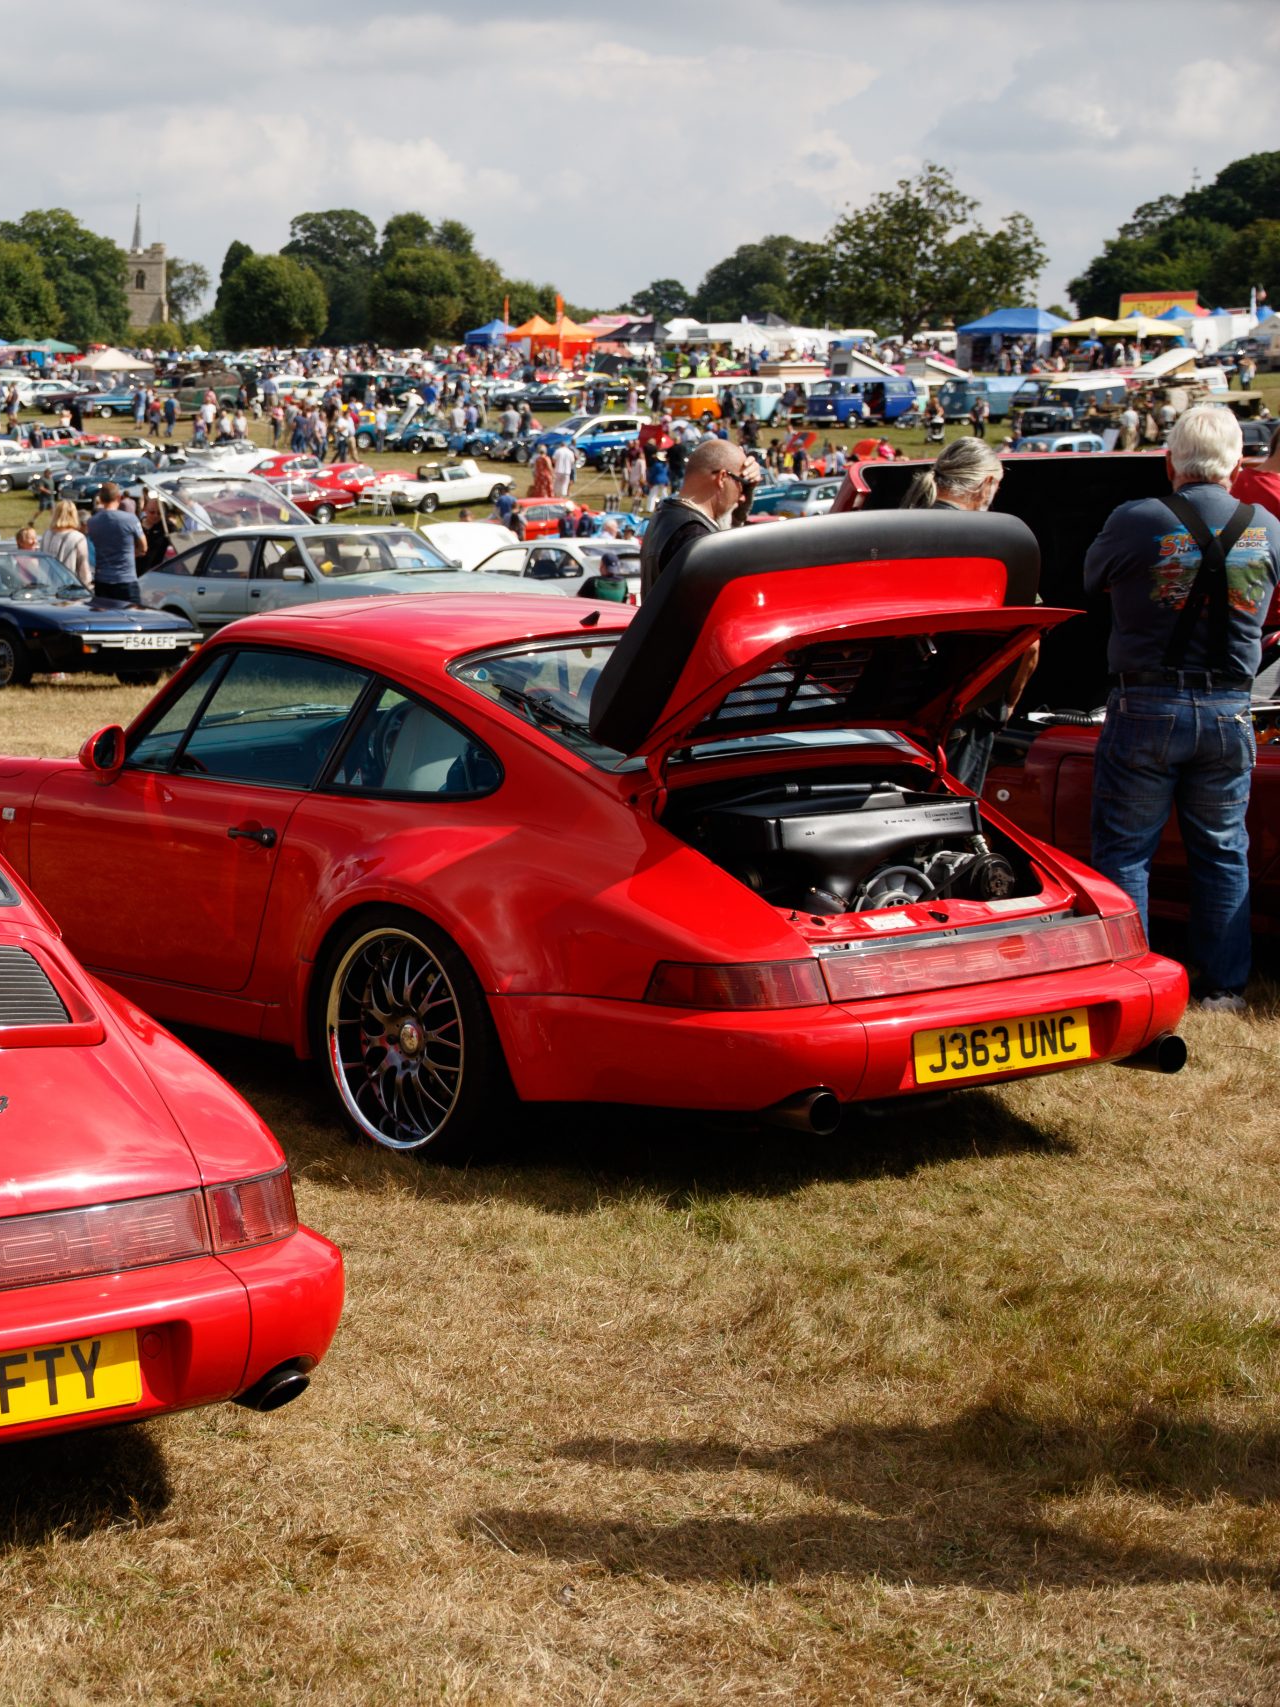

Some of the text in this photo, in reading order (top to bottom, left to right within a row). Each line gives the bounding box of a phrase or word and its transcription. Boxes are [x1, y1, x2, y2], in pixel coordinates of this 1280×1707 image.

[125, 636, 175, 648] F544 EFC
[929, 1016, 1077, 1074] J363 UNC
